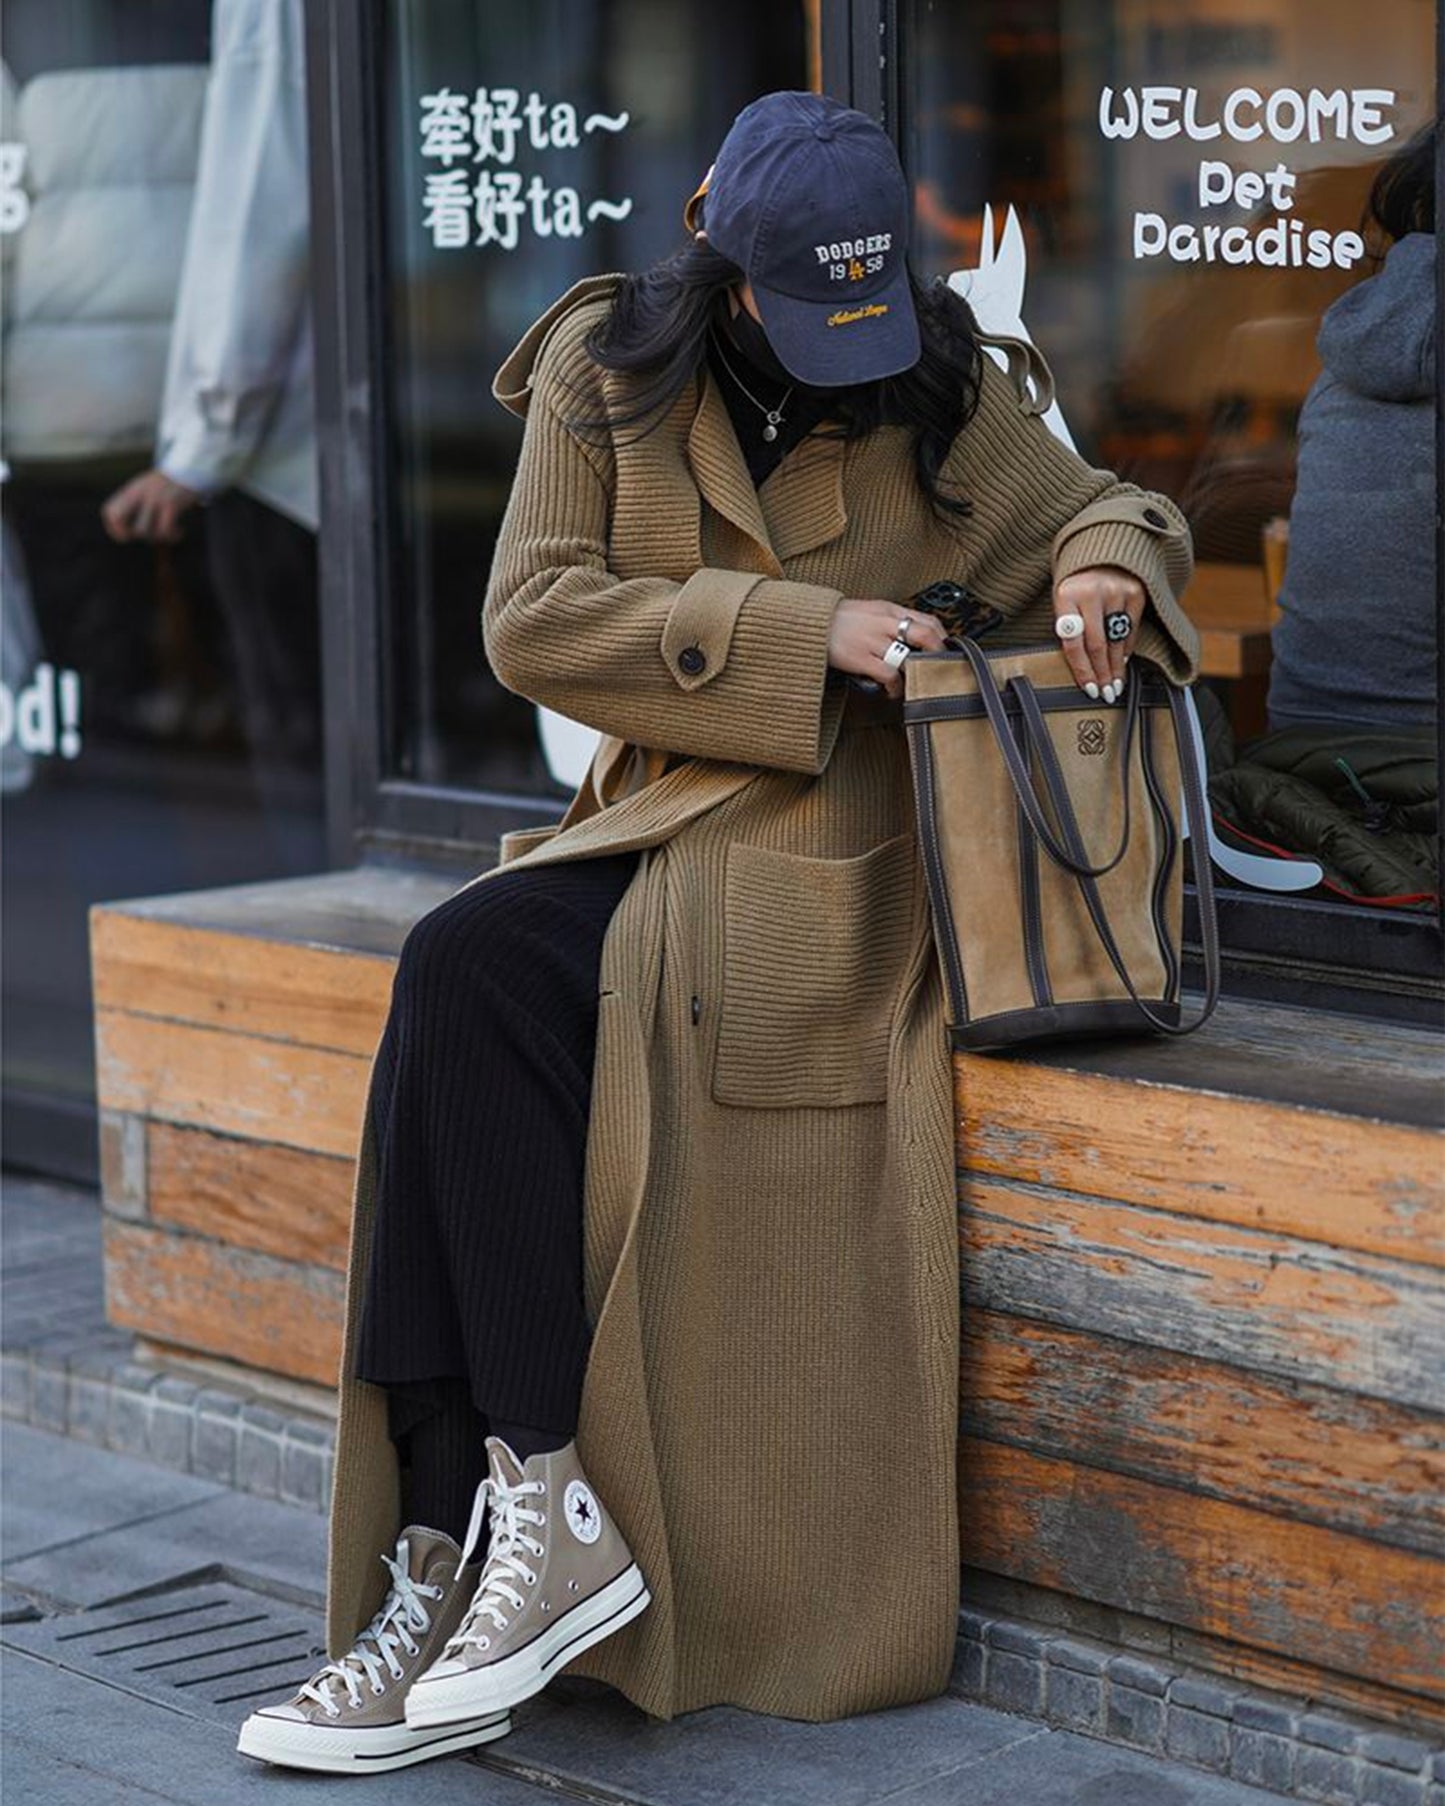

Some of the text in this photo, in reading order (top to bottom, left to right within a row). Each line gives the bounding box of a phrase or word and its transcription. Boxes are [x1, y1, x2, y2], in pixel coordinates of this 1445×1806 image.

[1099, 86, 1396, 145] WELCOME
[1199, 160, 1296, 211] Pet
[814, 233, 892, 264] DODGERS
[1133, 212, 1365, 269] Paradise
